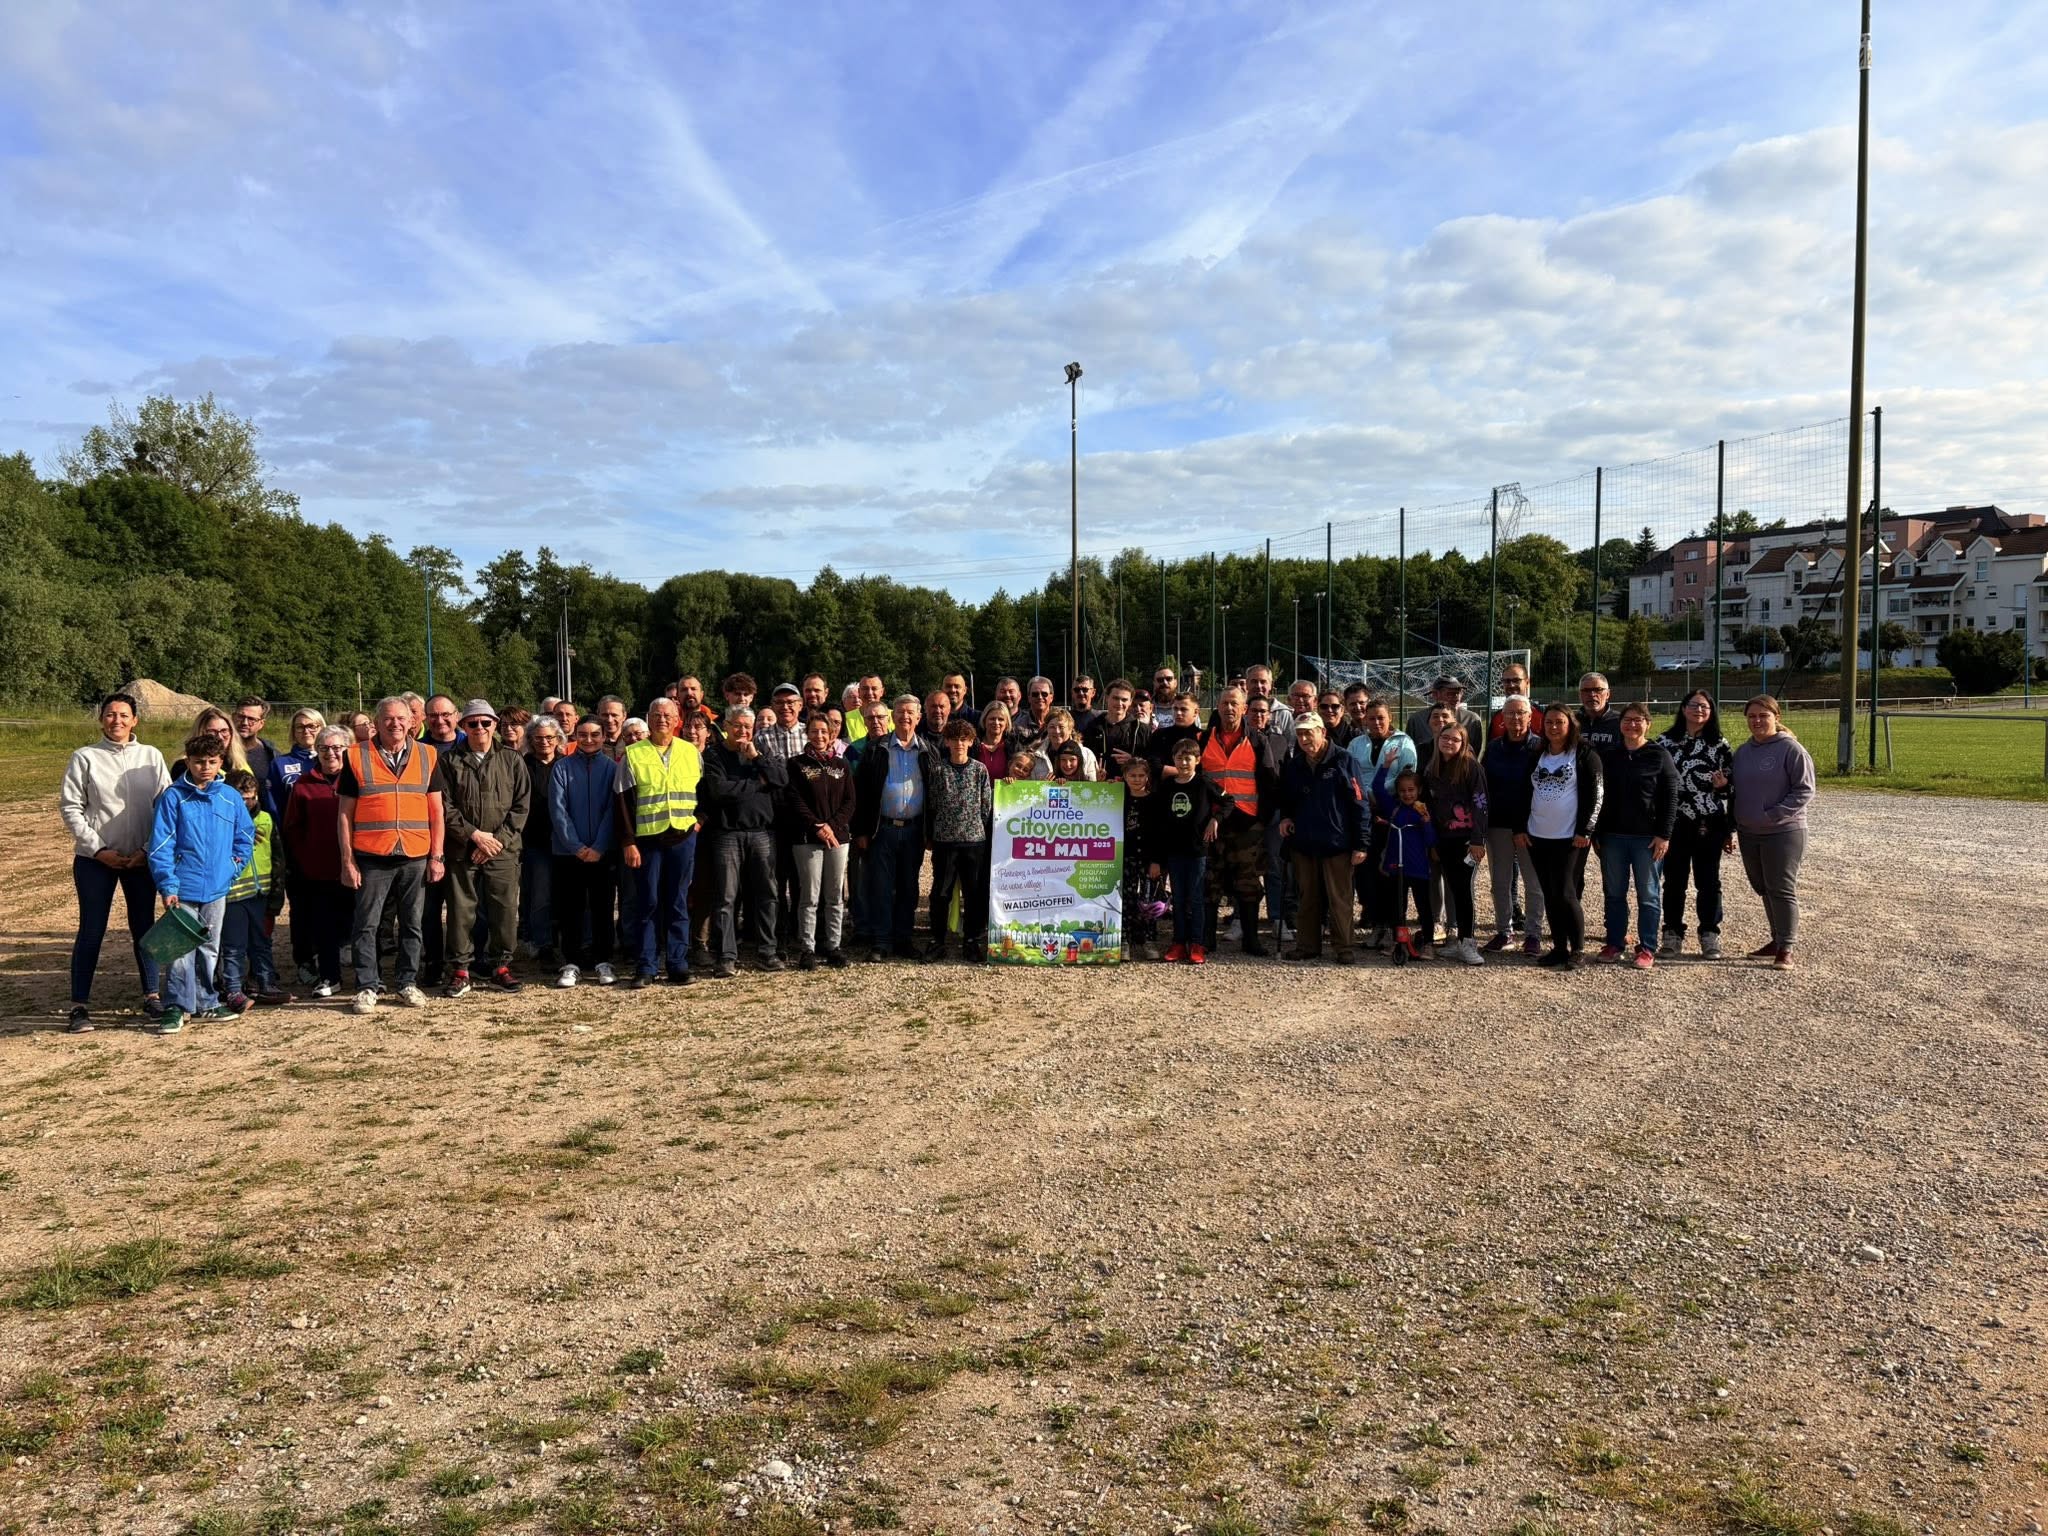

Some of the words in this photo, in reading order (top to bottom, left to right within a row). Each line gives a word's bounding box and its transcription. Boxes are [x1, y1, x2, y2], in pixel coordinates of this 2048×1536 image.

[1026, 807, 1083, 820] Journée
[1006, 817, 1110, 840] Citoyenne
[1025, 842, 1046, 857] 24
[1055, 843, 1087, 857] MAI
[1004, 897, 1073, 910] WALDIGHOFFEN
